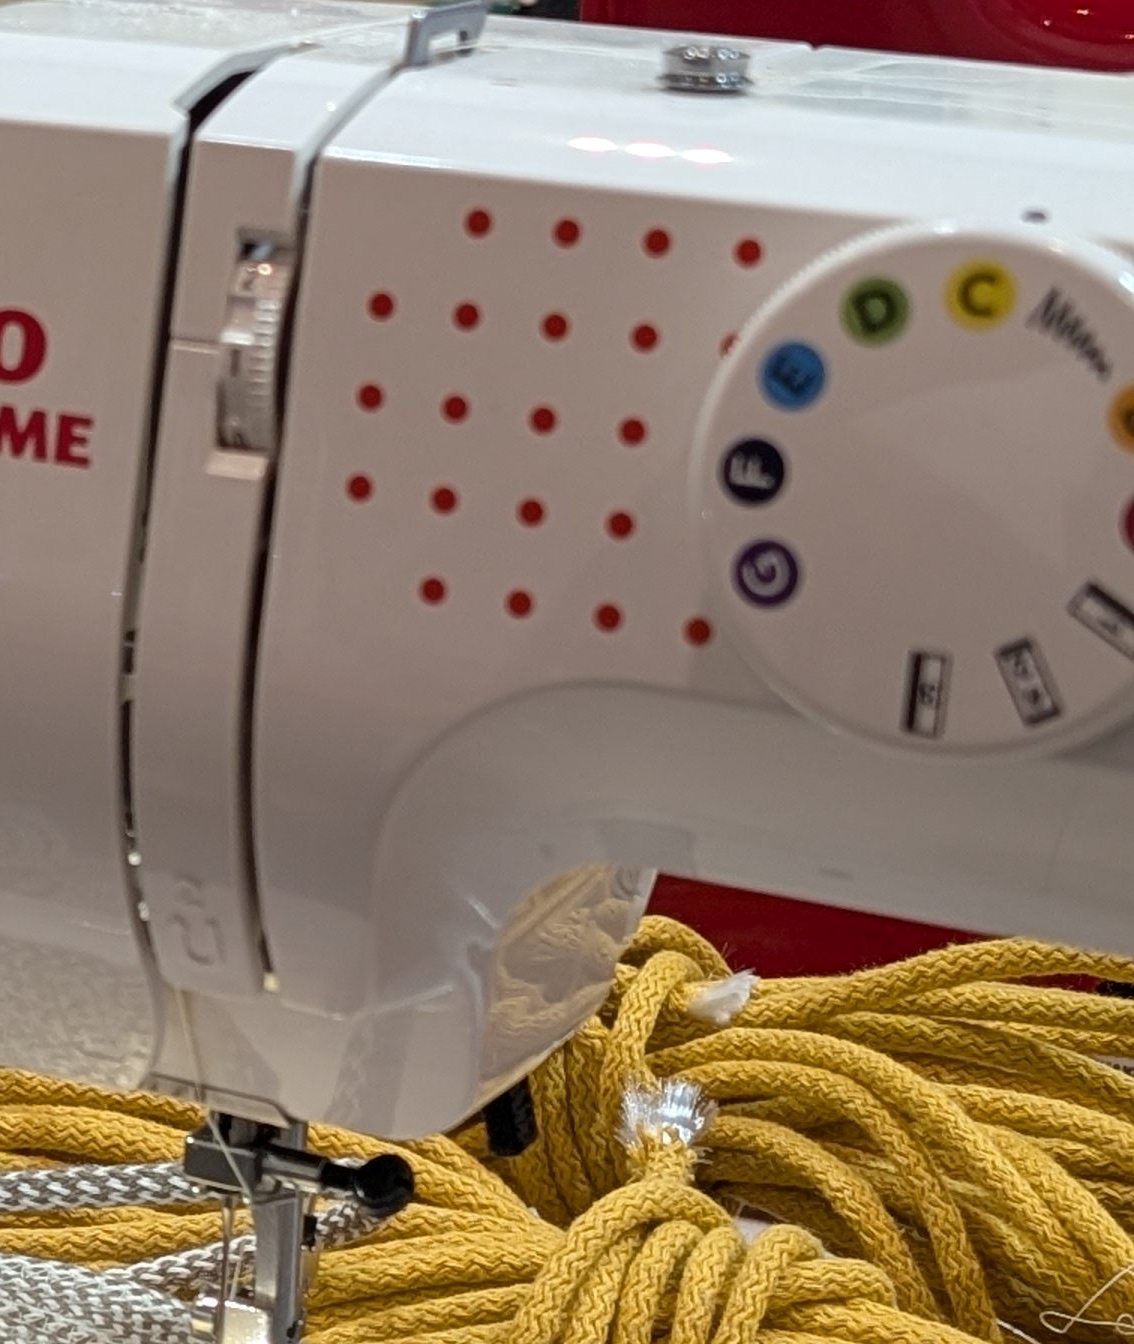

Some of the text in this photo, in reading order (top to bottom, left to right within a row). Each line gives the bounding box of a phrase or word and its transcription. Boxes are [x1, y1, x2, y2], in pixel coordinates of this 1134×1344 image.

[849, 288, 898, 333] D
[958, 273, 999, 318] C
[729, 451, 776, 490] F
[741, 553, 791, 597] G
